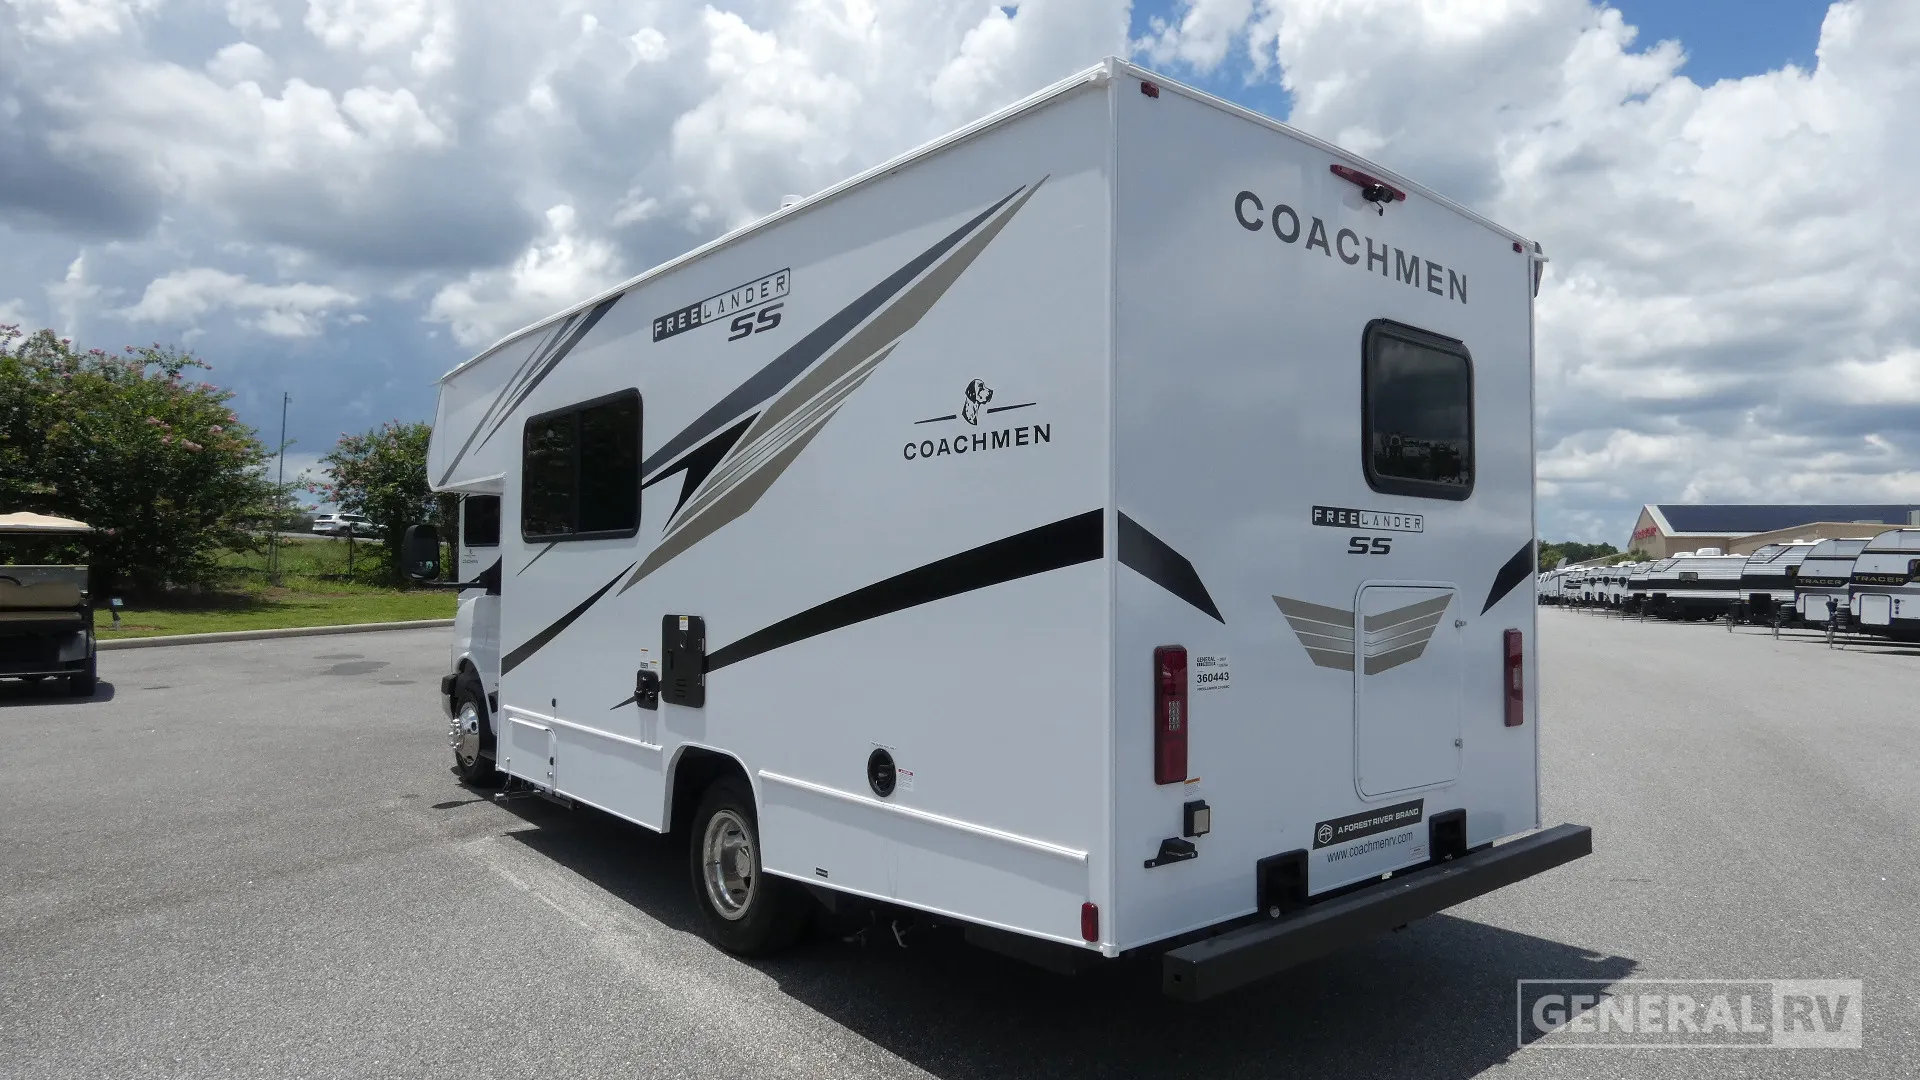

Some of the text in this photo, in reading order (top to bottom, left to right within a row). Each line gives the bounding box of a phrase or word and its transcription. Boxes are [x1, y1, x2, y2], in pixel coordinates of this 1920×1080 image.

[1235, 190, 1467, 305] COACHMEN
[654, 273, 787, 339] FREELANDER
[728, 302, 785, 342] SS
[903, 423, 1051, 460] COACHMEN
[1313, 508, 1421, 530] FREELANDER
[1347, 536, 1393, 555] SS
[1854, 575, 1904, 583] TRACER
[1196, 672, 1230, 684] 360443
[1337, 827, 1344, 835] A
[1344, 819, 1371, 832] FOREST
[1395, 808, 1419, 819] BRAND
[1326, 831, 1414, 863] www.coachmenrv.com
